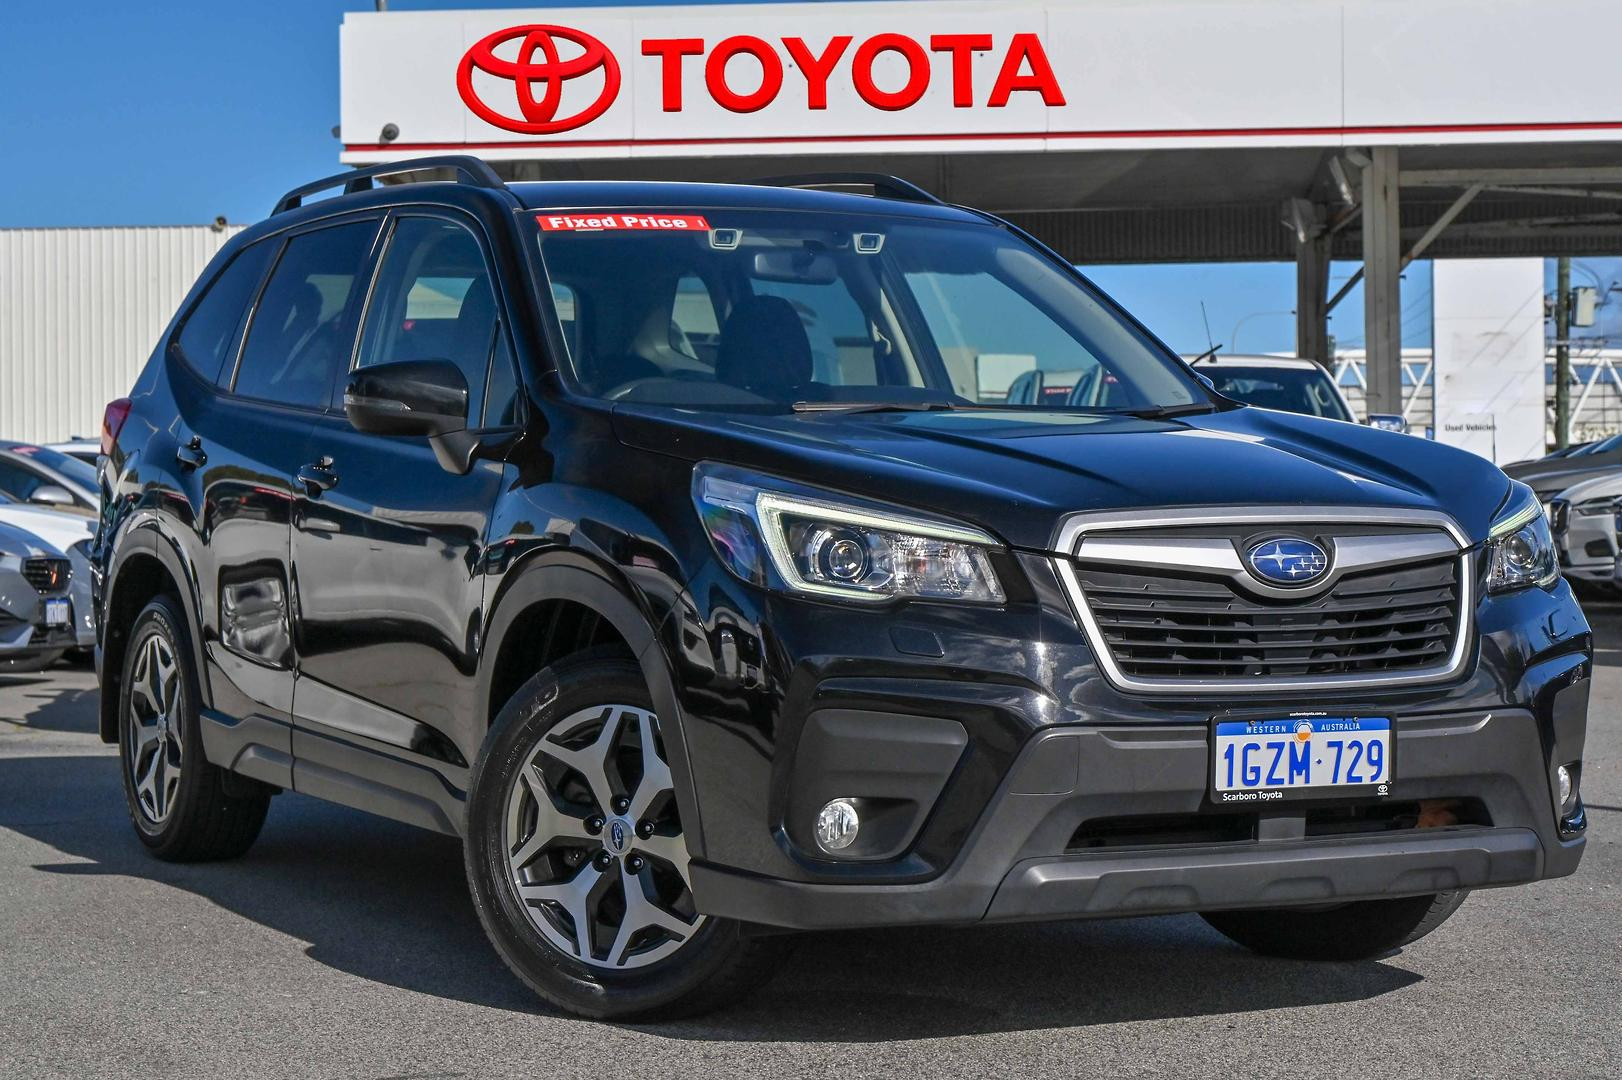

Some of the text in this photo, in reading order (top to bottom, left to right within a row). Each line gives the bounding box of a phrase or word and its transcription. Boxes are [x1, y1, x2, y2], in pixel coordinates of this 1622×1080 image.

[641, 33, 1066, 113] TOYOTA
[548, 216, 618, 229] Fixed
[621, 215, 689, 229] Price
[1445, 424, 1464, 432] Used
[1246, 721, 1361, 733] WESTERN AUSTRALIA
[1223, 790, 1283, 801] Scarboro Toyota
